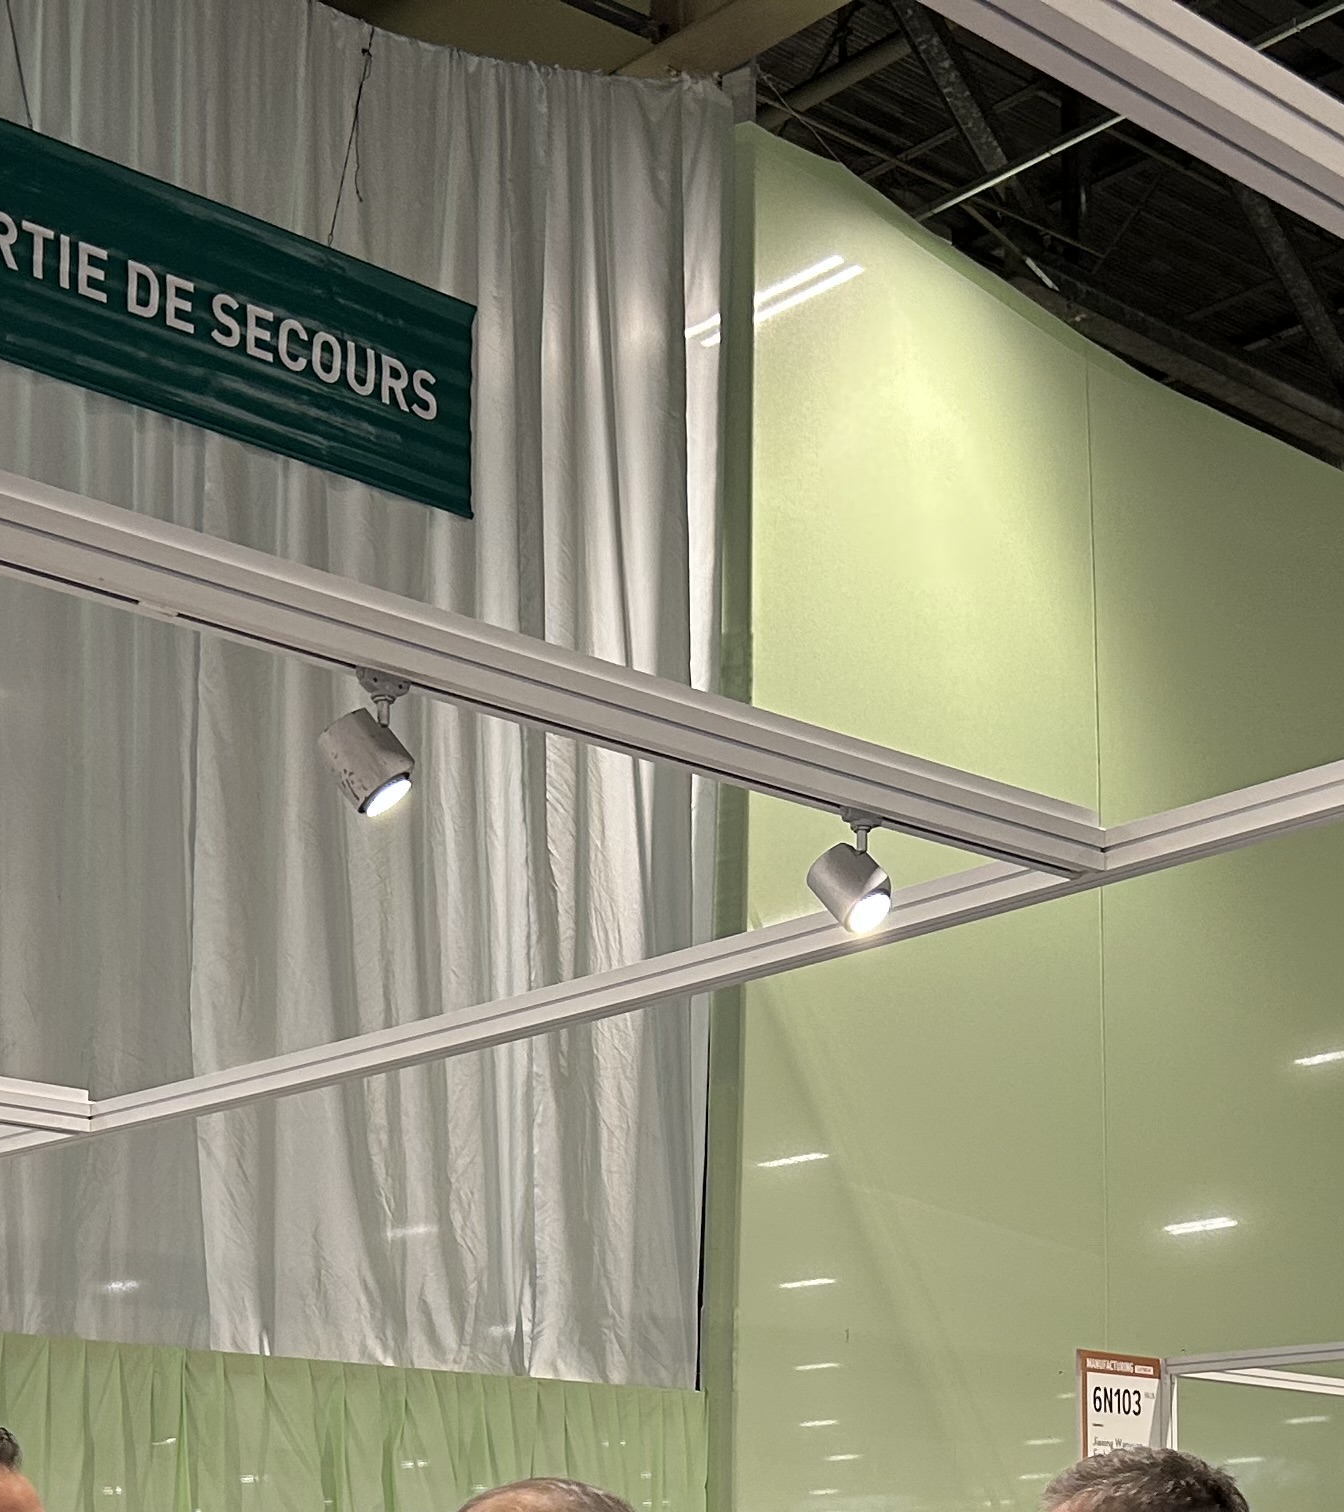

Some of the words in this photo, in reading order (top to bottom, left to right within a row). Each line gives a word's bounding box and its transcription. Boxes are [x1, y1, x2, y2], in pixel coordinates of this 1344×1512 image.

[127, 259, 195, 336] DE
[210, 293, 439, 423] SECOURS
[1093, 1386, 1142, 1416] 6N103
